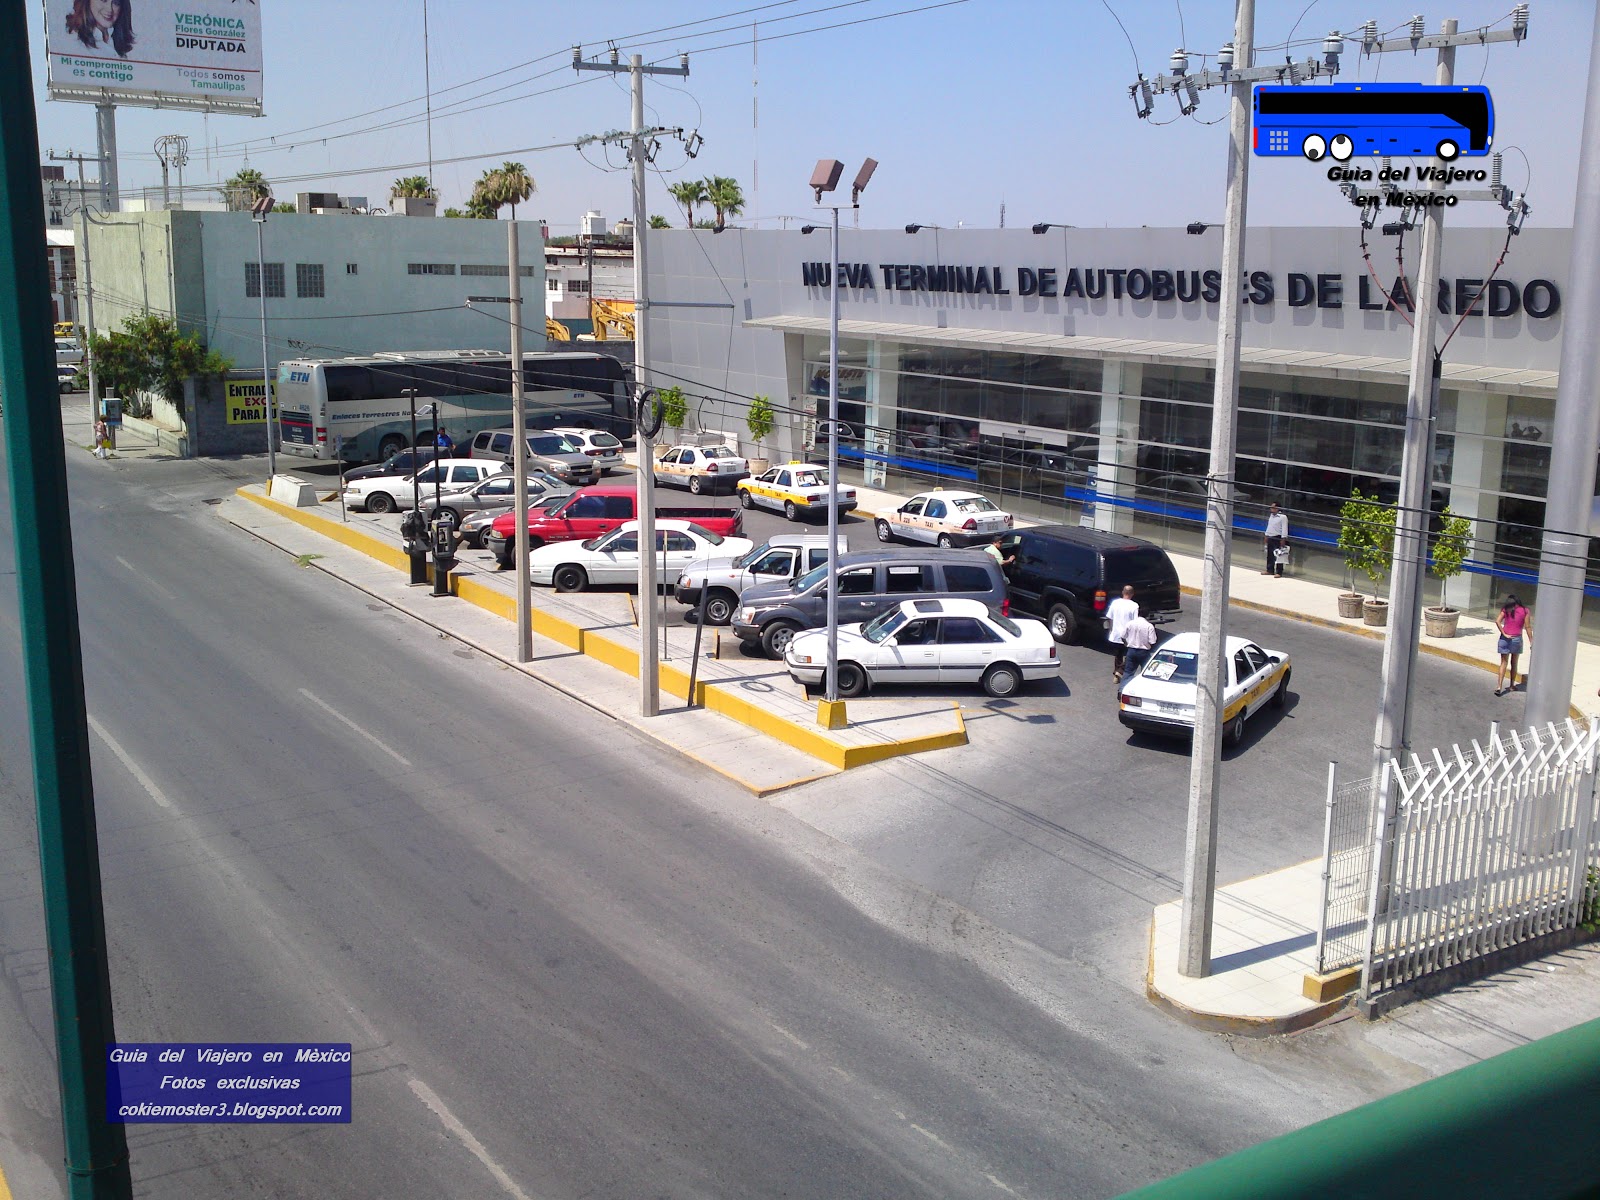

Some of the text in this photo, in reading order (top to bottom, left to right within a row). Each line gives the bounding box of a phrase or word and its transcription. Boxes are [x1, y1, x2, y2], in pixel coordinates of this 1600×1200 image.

[175, 13, 245, 29] VERÓNICA
[175, 25, 246, 38] Flores González
[176, 37, 246, 53] DIPUTADA
[61, 57, 133, 71] Mi compromiso
[73, 68, 133, 82] es contigo
[176, 68, 246, 81] Todos somos
[191, 79, 246, 91] Tamaulipas
[802, 262, 875, 289] NUEVA
[879, 264, 1010, 295] TERMINAL
[1018, 267, 1058, 297] DE
[1063, 267, 1274, 305] AUTOBUSS
[1288, 272, 1343, 308] DE
[290, 371, 310, 383] ETN
[233, 407, 260, 420] PARA
[362, 411, 400, 419] Terrestres
